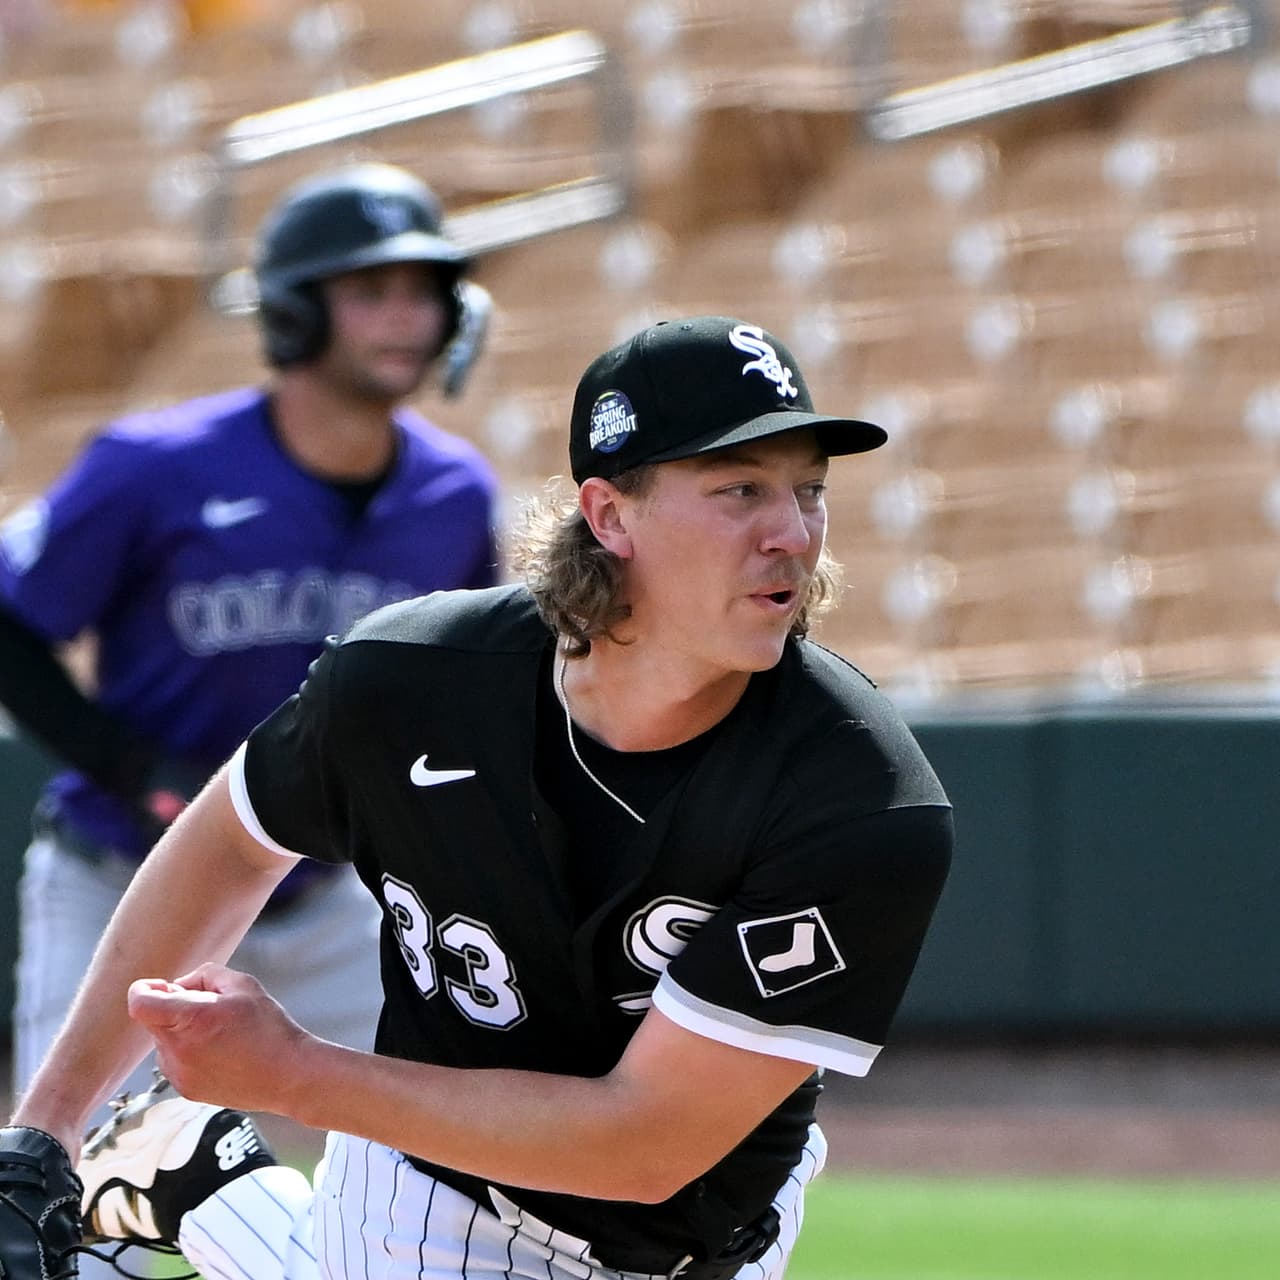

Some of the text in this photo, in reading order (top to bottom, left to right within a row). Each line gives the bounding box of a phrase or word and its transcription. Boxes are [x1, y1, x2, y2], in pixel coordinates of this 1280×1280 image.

[728, 325, 799, 398] Sox
[589, 414, 637, 450] BREAKOUT
[593, 404, 626, 430] SPRING
[381, 872, 528, 1031] 33
